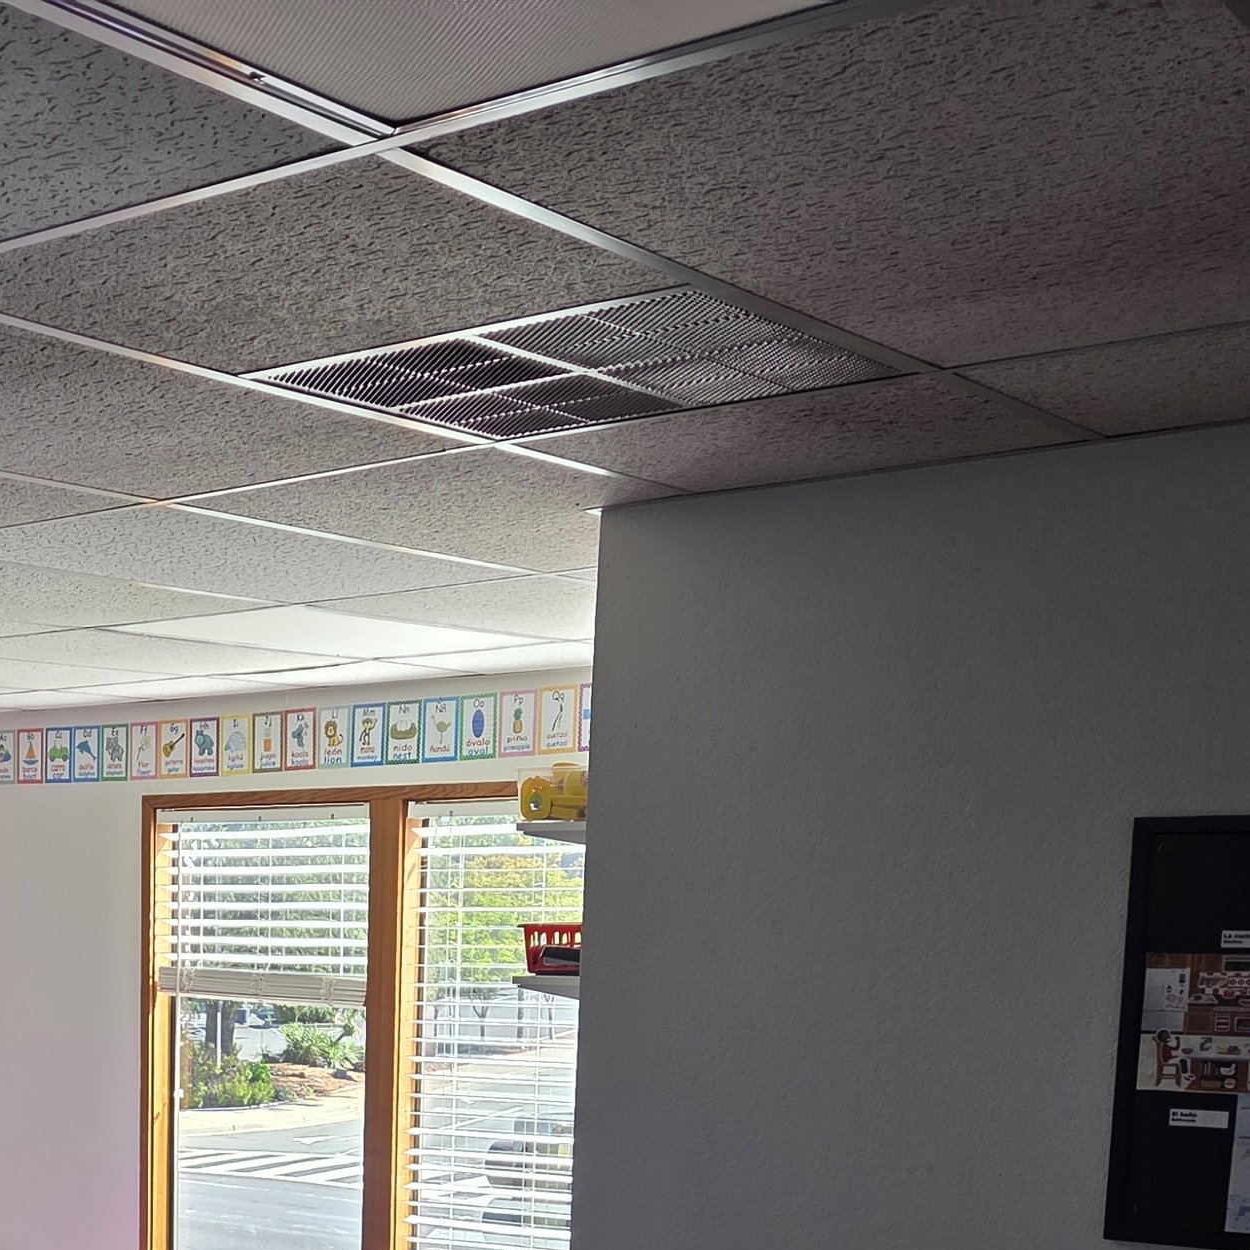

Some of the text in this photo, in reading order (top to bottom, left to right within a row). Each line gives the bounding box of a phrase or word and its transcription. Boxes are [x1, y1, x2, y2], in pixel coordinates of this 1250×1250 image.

[514, 694, 524, 704] Pp
[552, 691, 565, 702] Qq
[473, 699, 485, 708] Oo
[362, 708, 376, 717] Mm
[398, 704, 410, 714] Nn
[170, 723, 178, 734] Gg
[199, 722, 210, 730] Hh
[83, 729, 92, 738] Dd
[466, 738, 491, 747] óvalo
[506, 735, 528, 744] piña
[324, 747, 342, 755] león
[393, 743, 413, 752] nido
[467, 746, 489, 755] oval
[291, 750, 309, 758] koala
[392, 752, 412, 760] nest
[324, 756, 342, 764] lion
